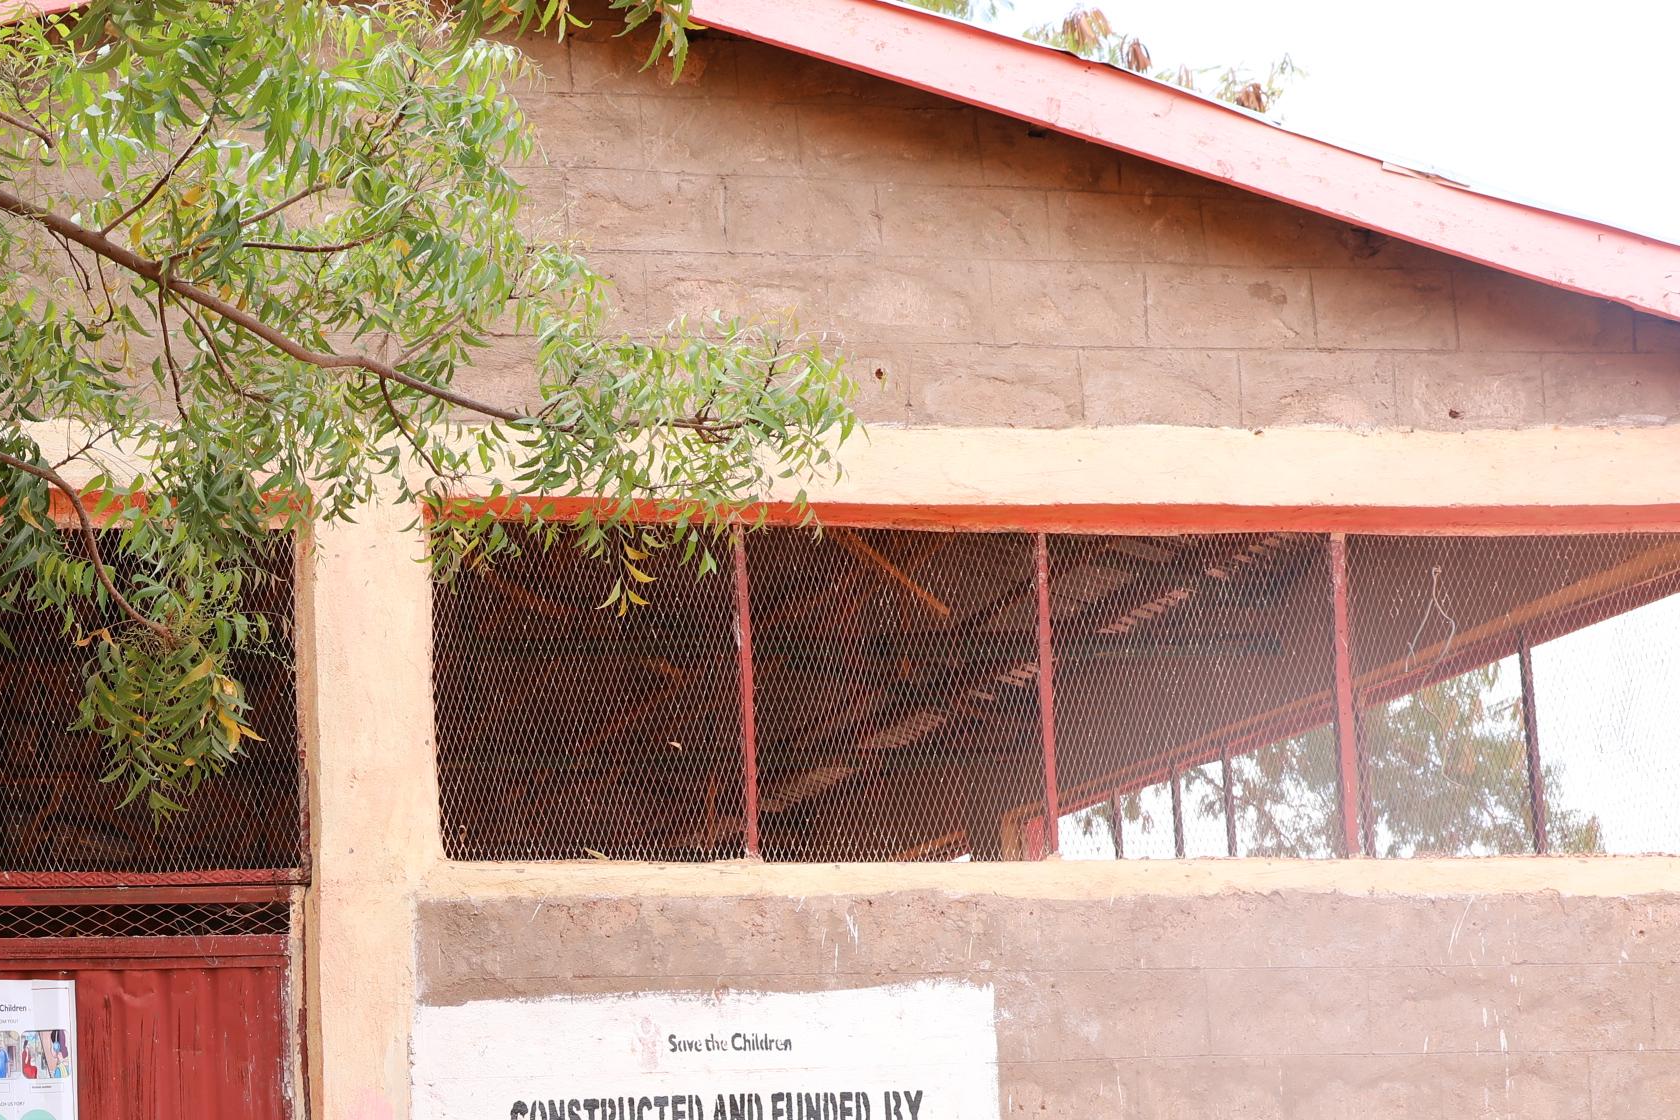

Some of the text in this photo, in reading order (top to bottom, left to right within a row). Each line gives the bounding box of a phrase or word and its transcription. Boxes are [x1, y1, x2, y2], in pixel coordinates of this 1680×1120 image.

[0, 1003, 27, 1012] Children
[668, 1032, 793, 1053] Save the Children
